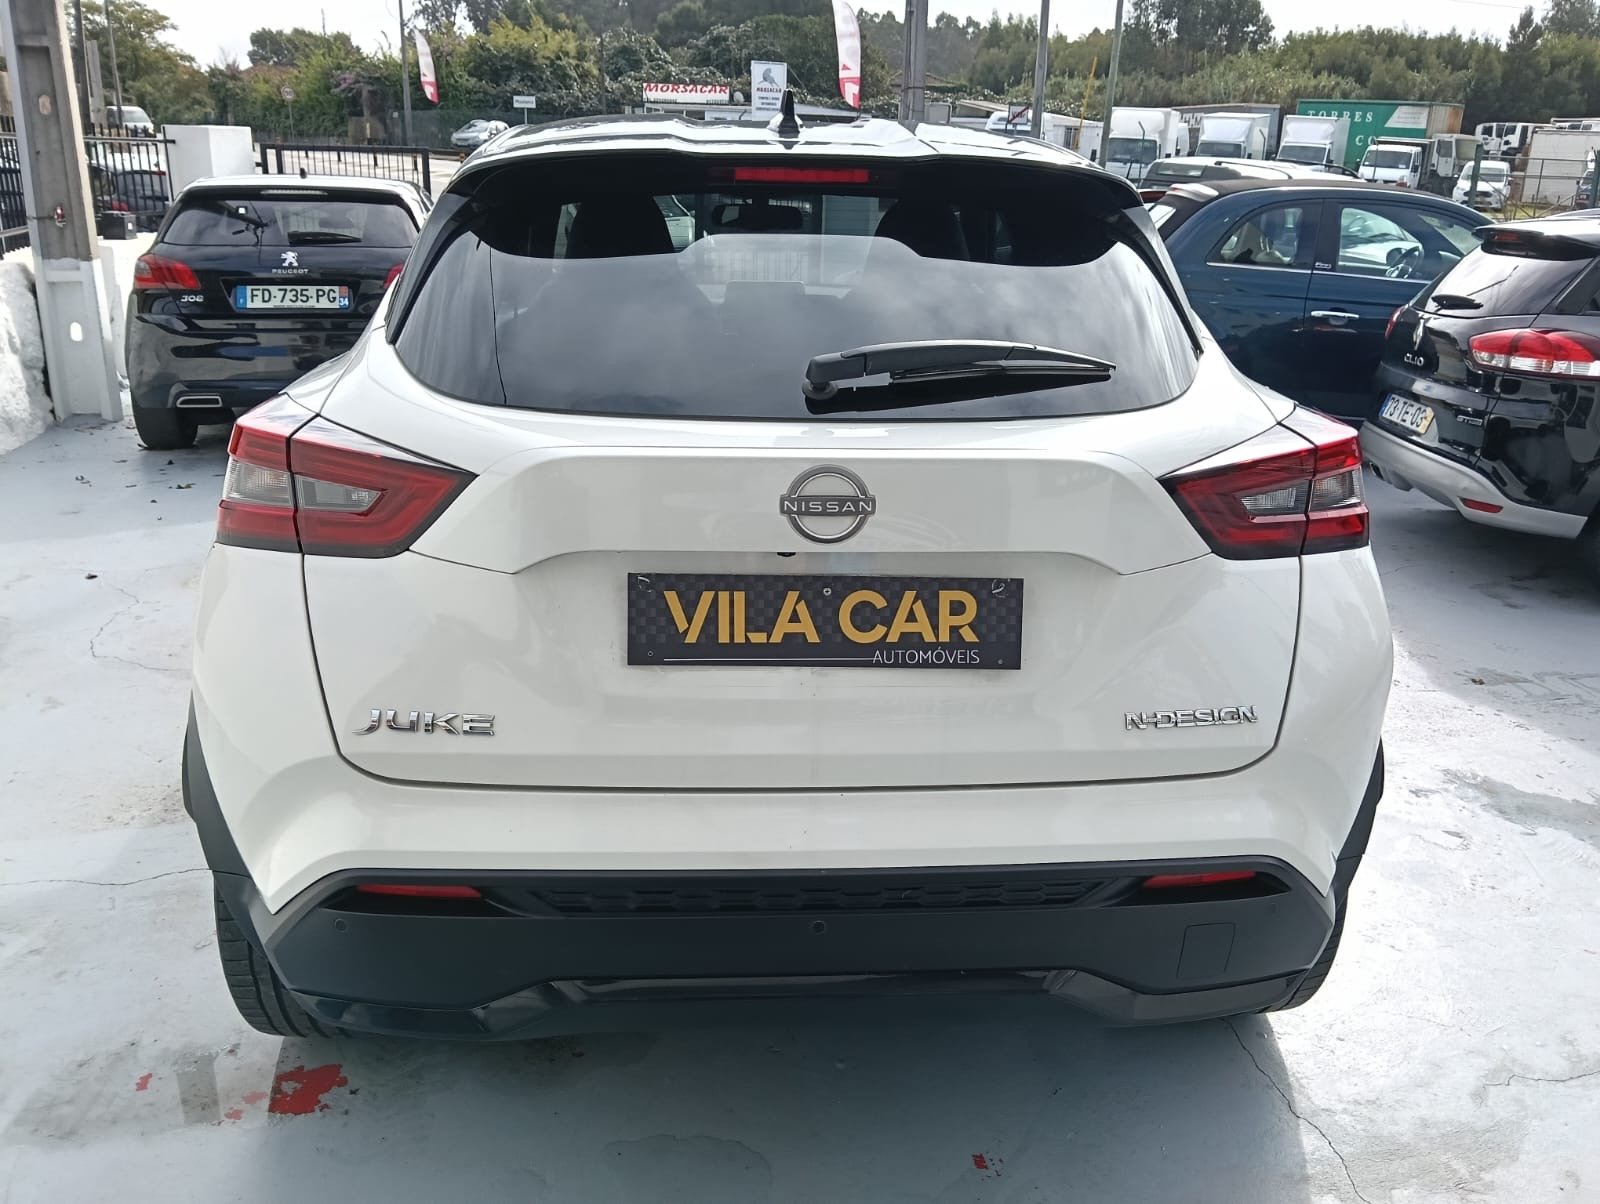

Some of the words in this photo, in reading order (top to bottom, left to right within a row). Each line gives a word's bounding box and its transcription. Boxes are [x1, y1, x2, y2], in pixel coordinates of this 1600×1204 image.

[645, 83, 729, 94] MORSACAR
[249, 288, 338, 304] FD-735-PG
[1404, 352, 1425, 367] CLIO
[1384, 397, 1428, 428] 73-TE-03
[783, 499, 873, 513] NISSAN
[663, 590, 821, 644] VILA
[838, 589, 980, 644] CAR
[872, 647, 980, 665] AUTOMÓVEIS
[351, 708, 496, 736] JUKE
[1124, 705, 1258, 730] N-DESIGN
